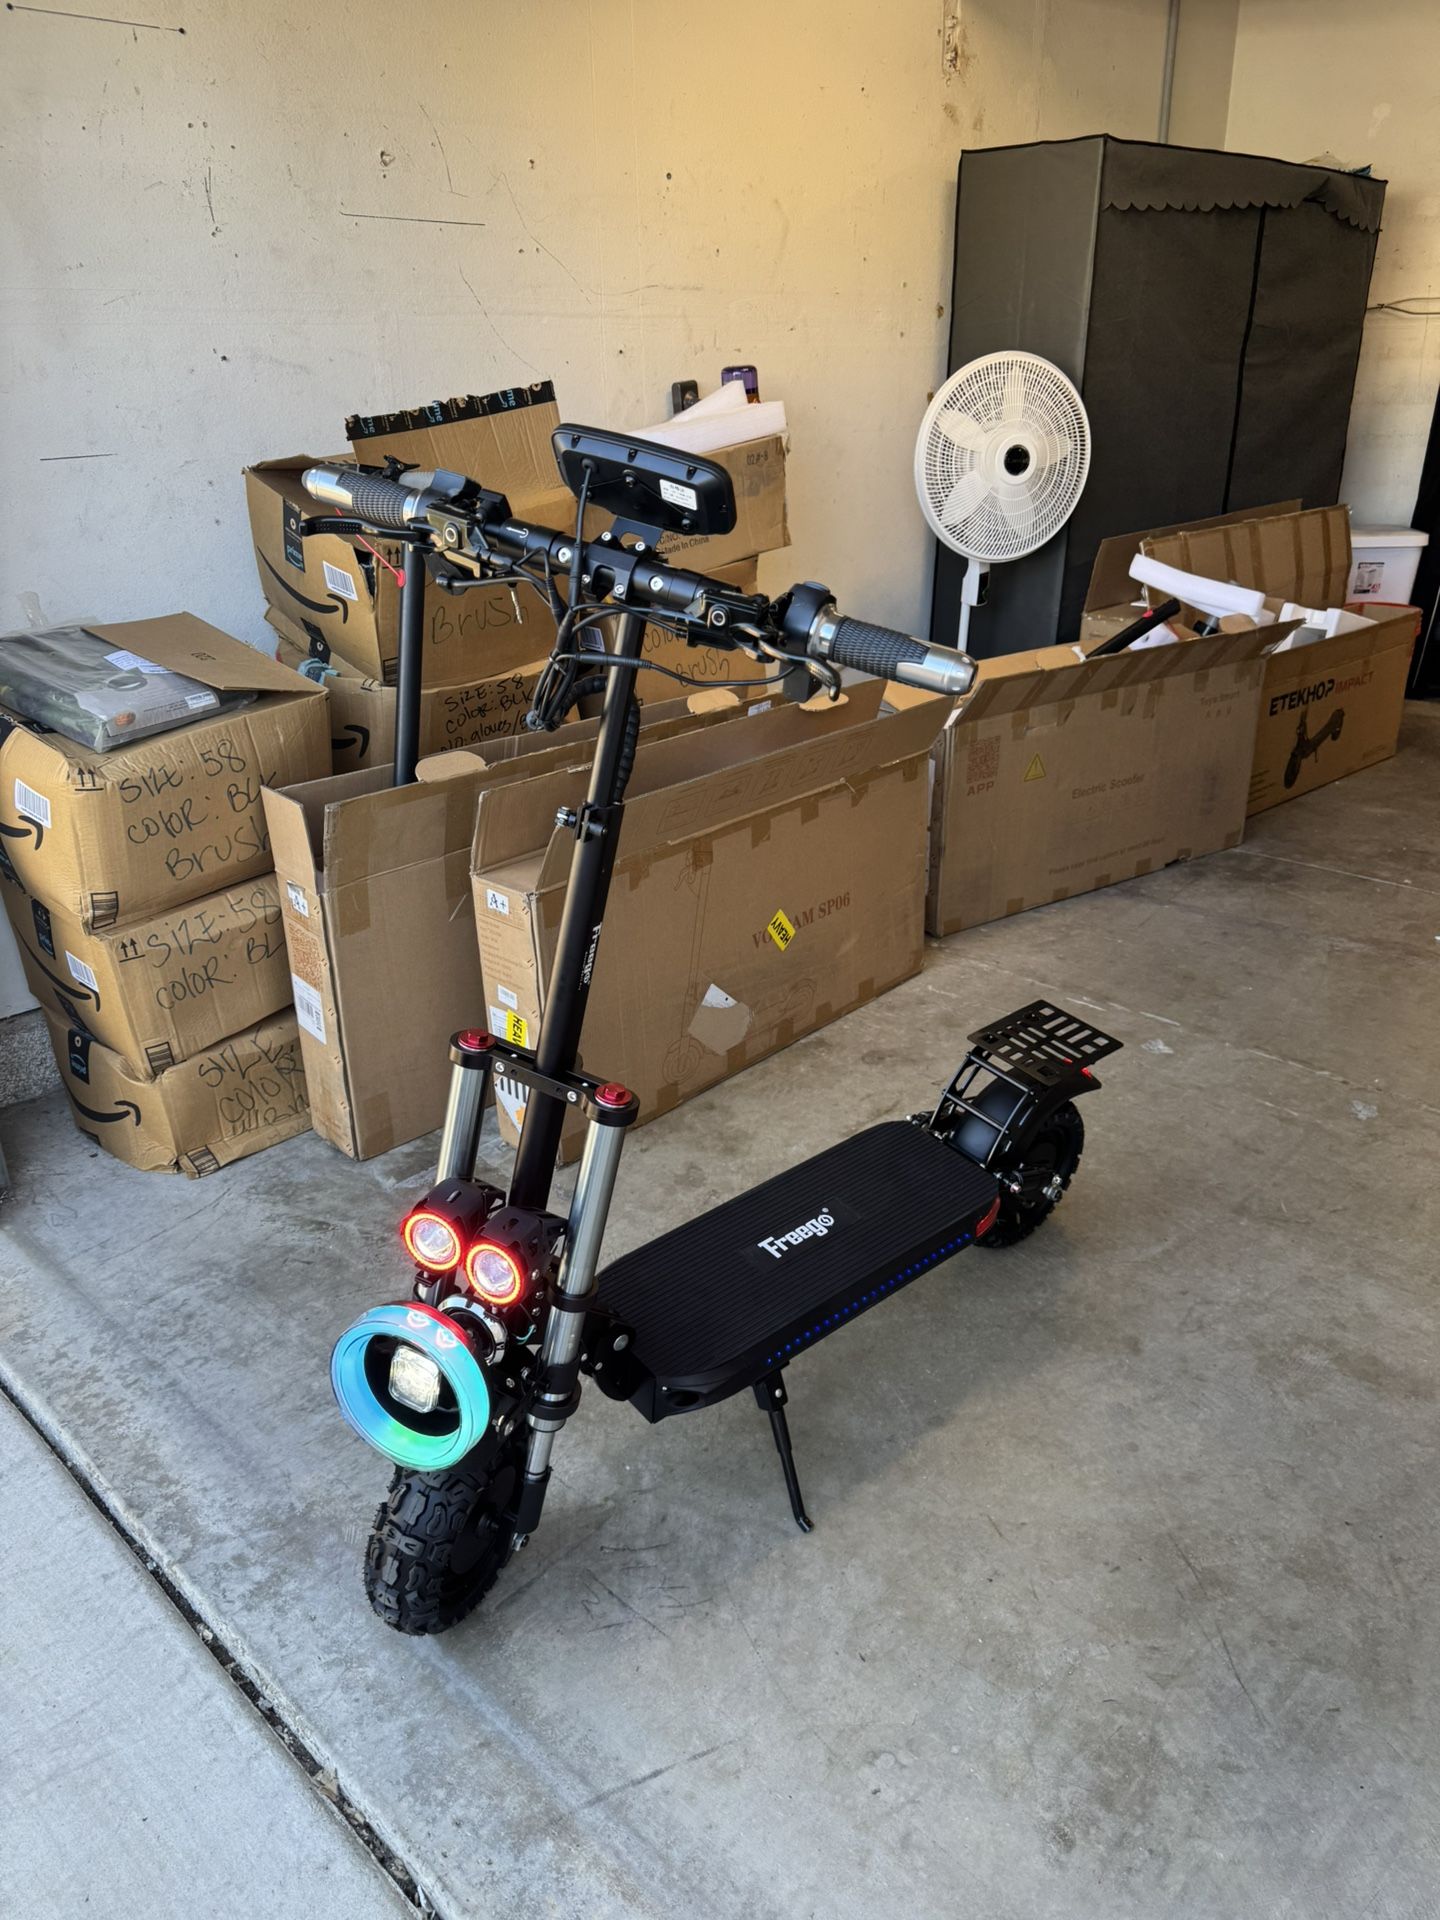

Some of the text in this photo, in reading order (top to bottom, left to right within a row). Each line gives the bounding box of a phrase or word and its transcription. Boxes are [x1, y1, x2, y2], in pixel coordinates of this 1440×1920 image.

[689, 536, 710, 547] China
[1268, 678, 1335, 717] ETEKHOP
[201, 738, 246, 777] 58
[966, 781, 995, 797] APP
[1072, 774, 1145, 799] Electric Scooter
[231, 887, 281, 933] 58
[818, 891, 850, 919] SP06
[770, 917, 792, 945] HEAVY
[583, 921, 603, 985] Freego
[757, 1208, 834, 1259] Freego
